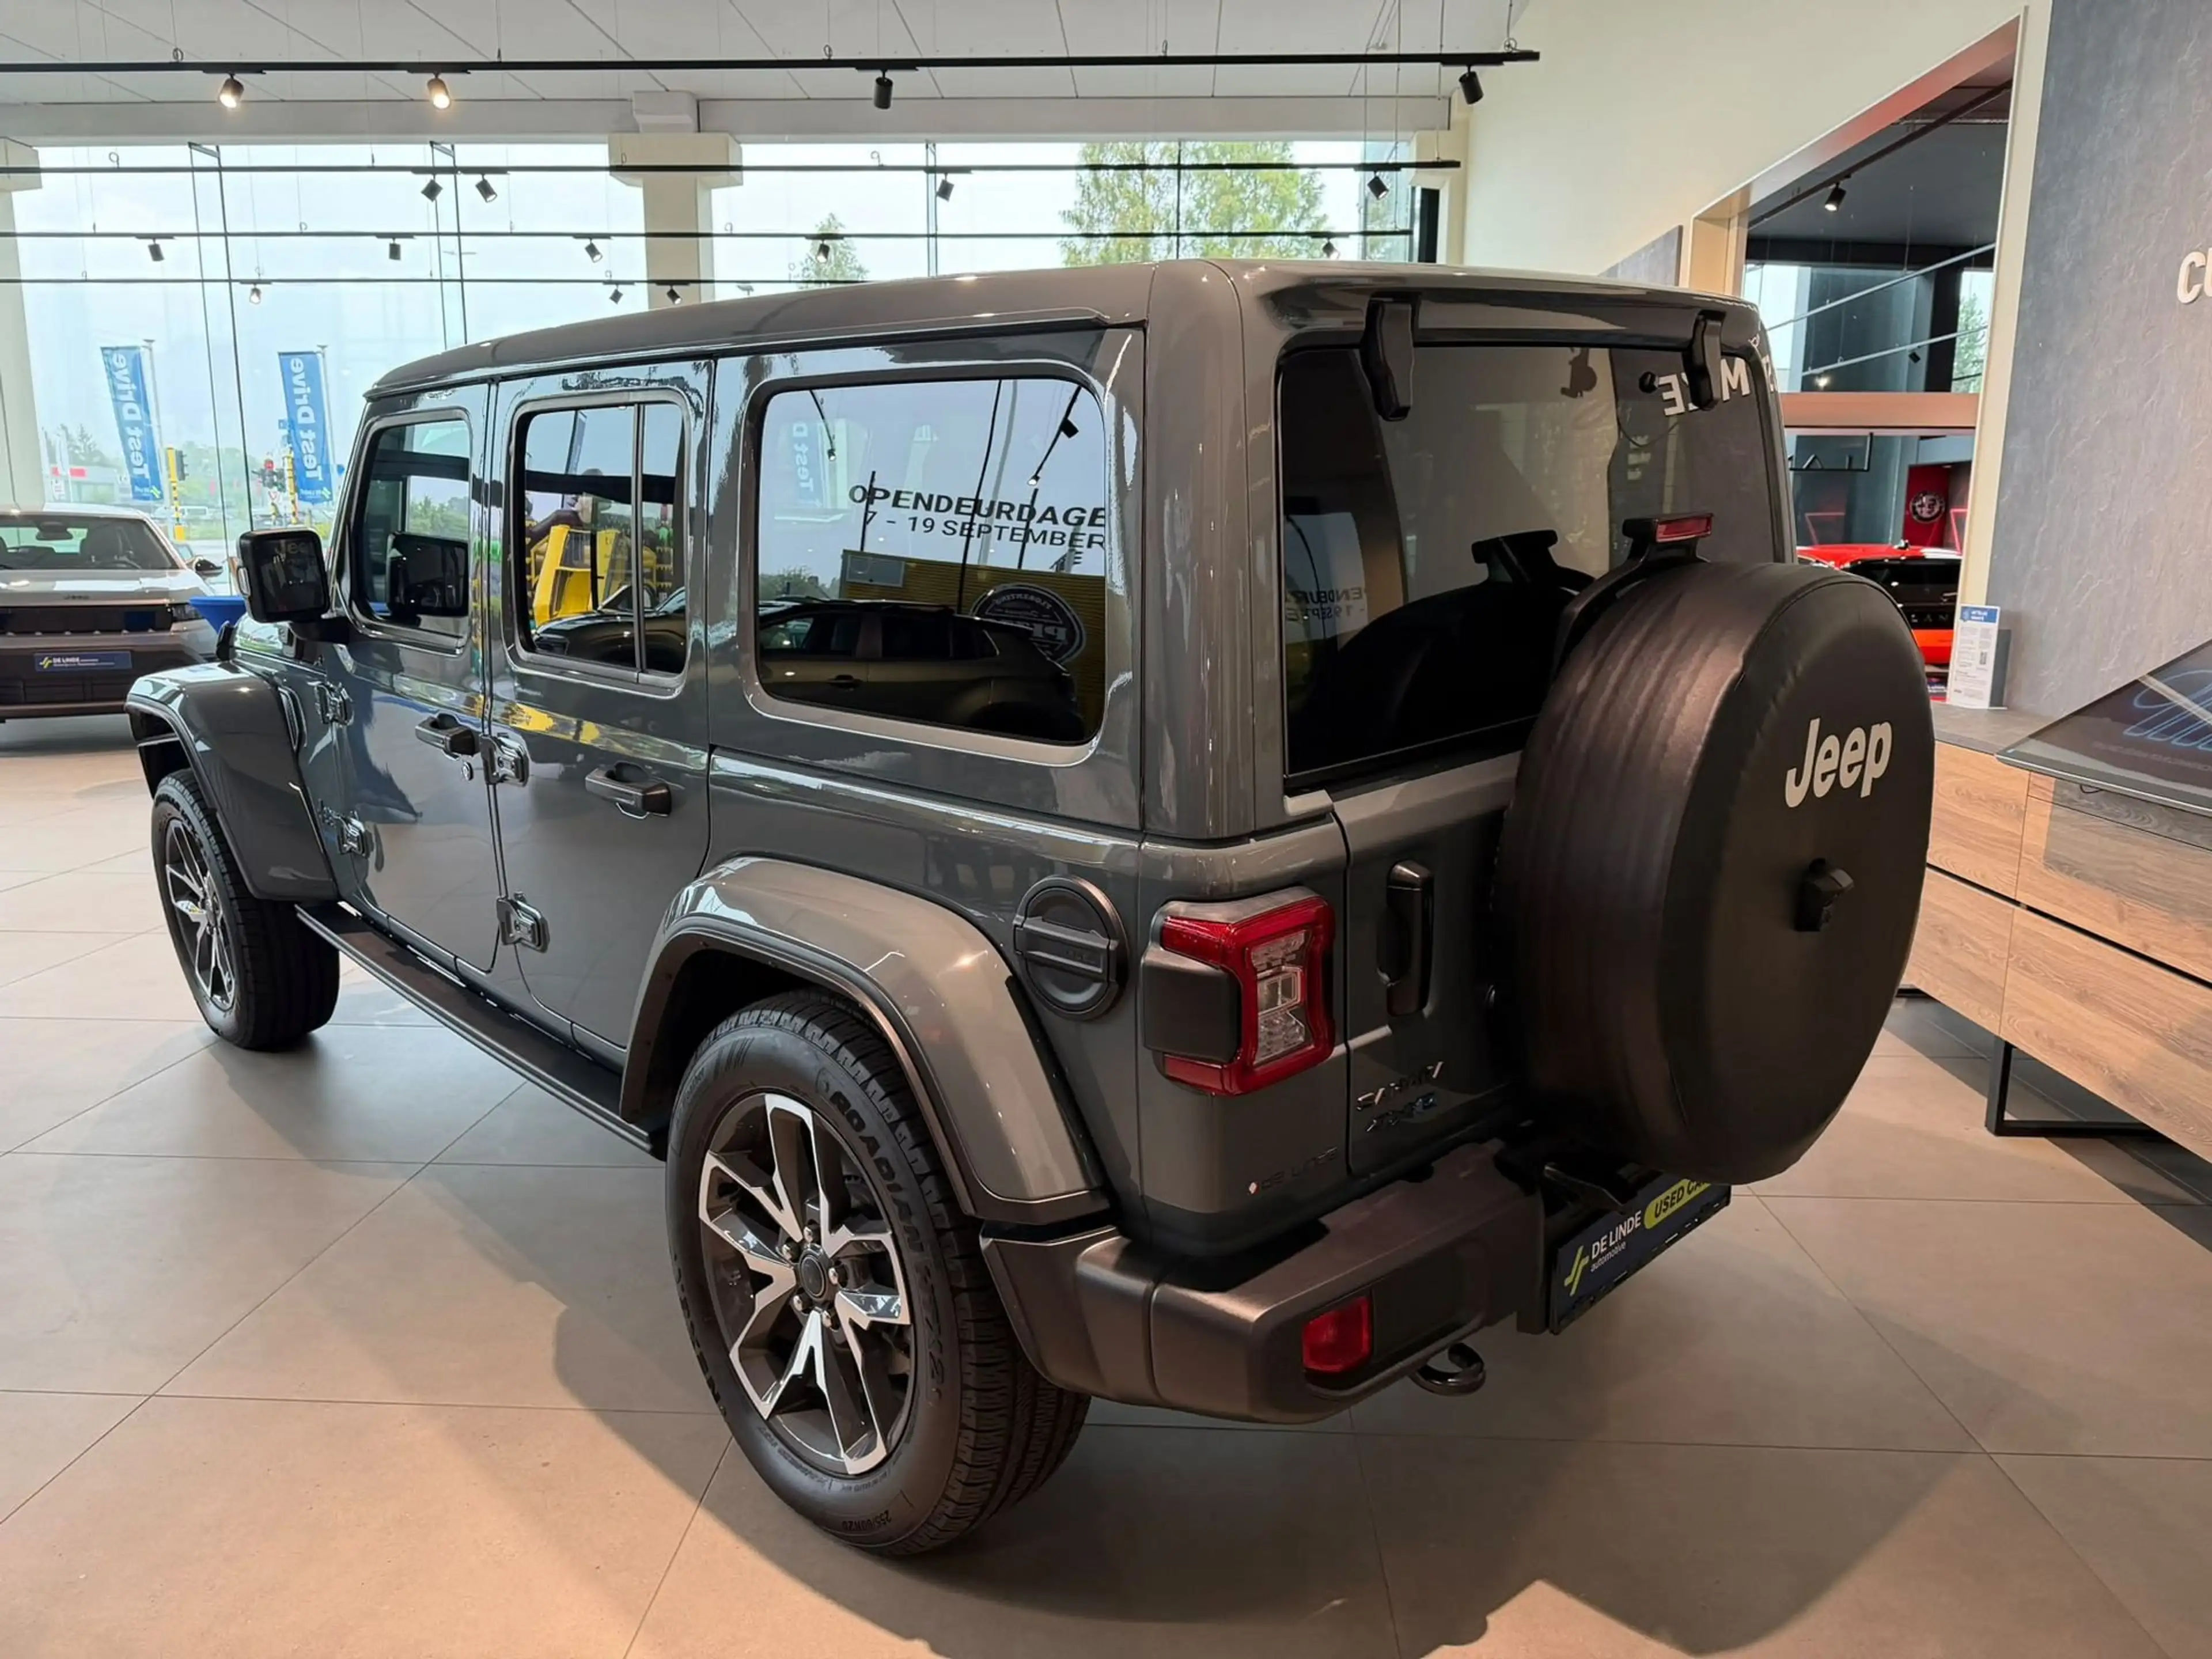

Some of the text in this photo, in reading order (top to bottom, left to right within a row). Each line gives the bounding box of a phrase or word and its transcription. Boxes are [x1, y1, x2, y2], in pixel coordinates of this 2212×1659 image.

[2177, 247, 2212, 304] C
[907, 516, 935, 533] 19
[1785, 718, 1892, 808] Jeep
[1591, 1234, 1608, 1260] DE
[1609, 1210, 1642, 1247] LINDE
[1654, 1185, 1685, 1219] USED
